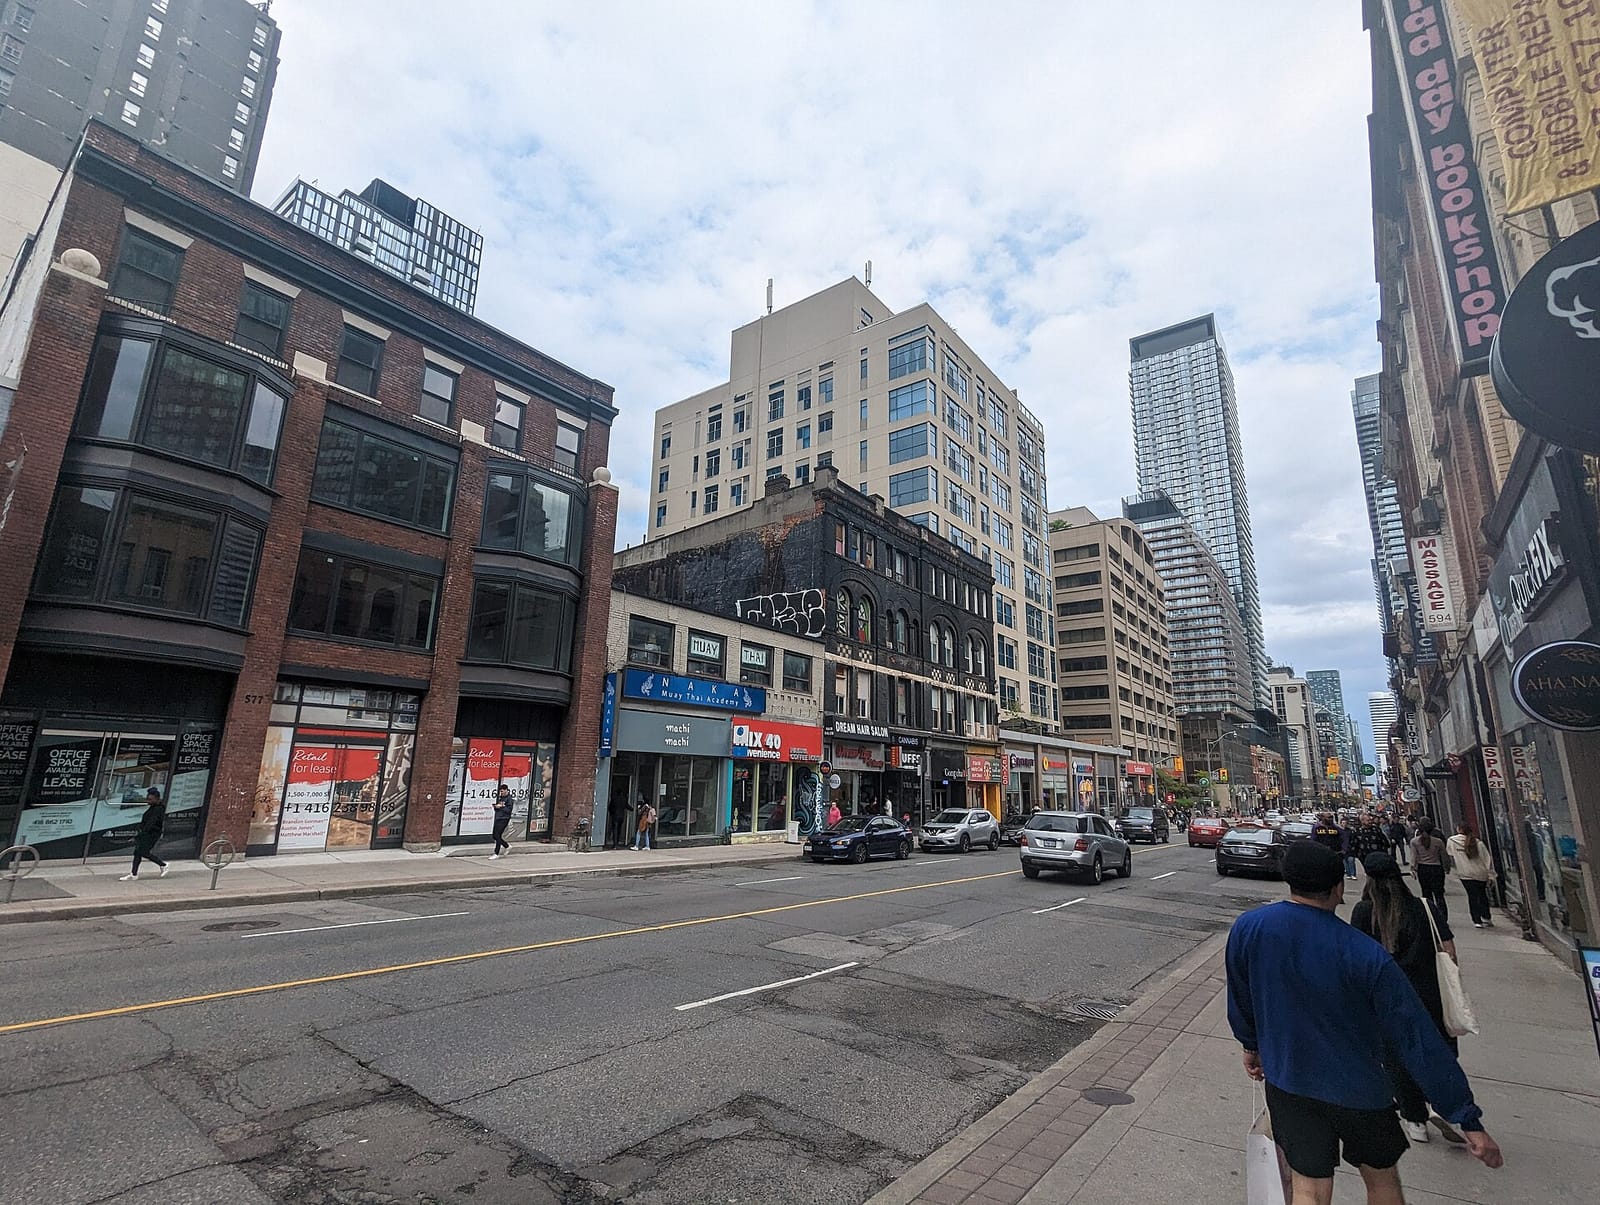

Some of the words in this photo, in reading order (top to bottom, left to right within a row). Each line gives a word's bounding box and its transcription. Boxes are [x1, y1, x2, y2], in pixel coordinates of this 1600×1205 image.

[1477, 19, 1538, 160] COMPUTER
[1415, 58, 1455, 135] day
[1531, 60, 1585, 158] MOBILE
[1557, 158, 1590, 179] &
[1430, 143, 1500, 347] bookshop
[1417, 538, 1446, 611] MASSAGE
[1428, 613, 1451, 624] 594
[692, 640, 719, 656] MUAY
[743, 649, 766, 665] THAI
[661, 677, 739, 697] NAKA
[1526, 677, 1566, 690] AHA
[245, 694, 263, 704] 577
[661, 690, 683, 700] Muay
[686, 694, 703, 702] Thai
[706, 697, 739, 706] Academy
[665, 723, 690, 733] machi
[835, 721, 856, 734] DREAM
[857, 724, 870, 736] HAIR
[871, 726, 888, 738] SALON
[1406, 713, 1418, 751] ELIOTS
[182, 733, 213, 742] OFFICE
[664, 736, 689, 747] machi
[765, 733, 781, 750] 40
[898, 736, 919, 745] CANNABIS
[49, 749, 91, 759] OFFICE
[292, 749, 328, 762] Retail
[468, 748, 494, 758] Retail
[49, 758, 87, 768] SPACE
[178, 756, 209, 764] LEASE
[468, 759, 479, 768] for
[480, 759, 501, 769] lease
[1484, 748, 1502, 778] SPA
[292, 763, 308, 774] for
[310, 763, 337, 775] lease
[1001, 755, 1009, 785] MEXICO
[42, 777, 85, 788] LEASE
[464, 789, 476, 799] +1
[479, 789, 498, 798] 416
[284, 803, 301, 814] +1
[304, 803, 330, 814] 416
[381, 802, 395, 812] 68
